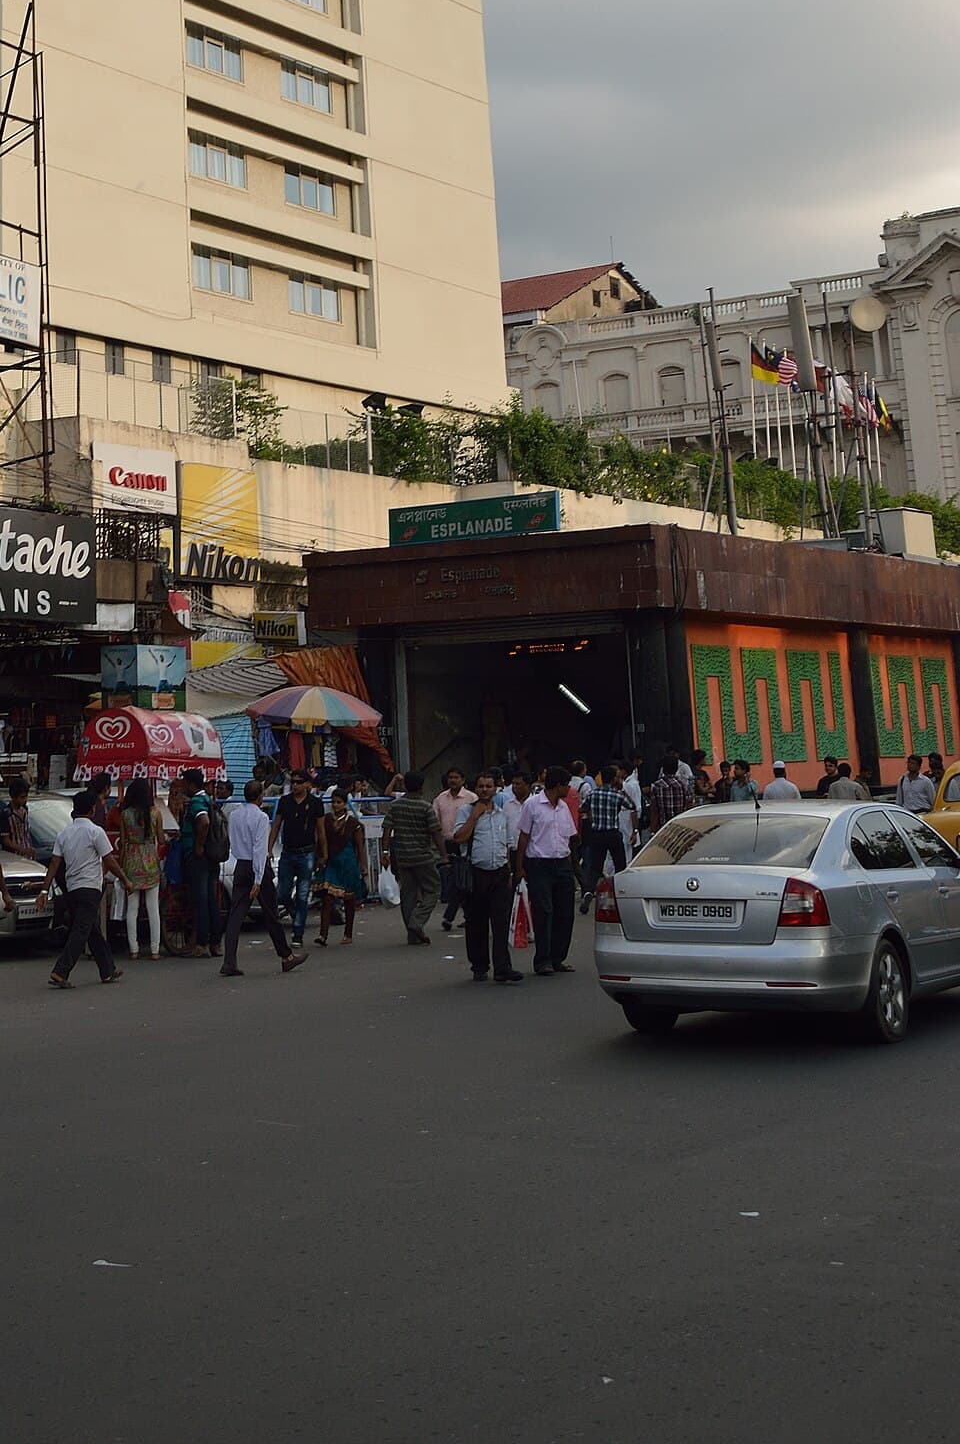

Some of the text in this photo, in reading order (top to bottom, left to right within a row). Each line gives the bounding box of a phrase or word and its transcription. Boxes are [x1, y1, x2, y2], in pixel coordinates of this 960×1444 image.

[108, 465, 167, 492] Canon
[430, 516, 513, 539] ESPLANADE
[185, 540, 262, 582] Nikon
[256, 619, 296, 638] Nikon
